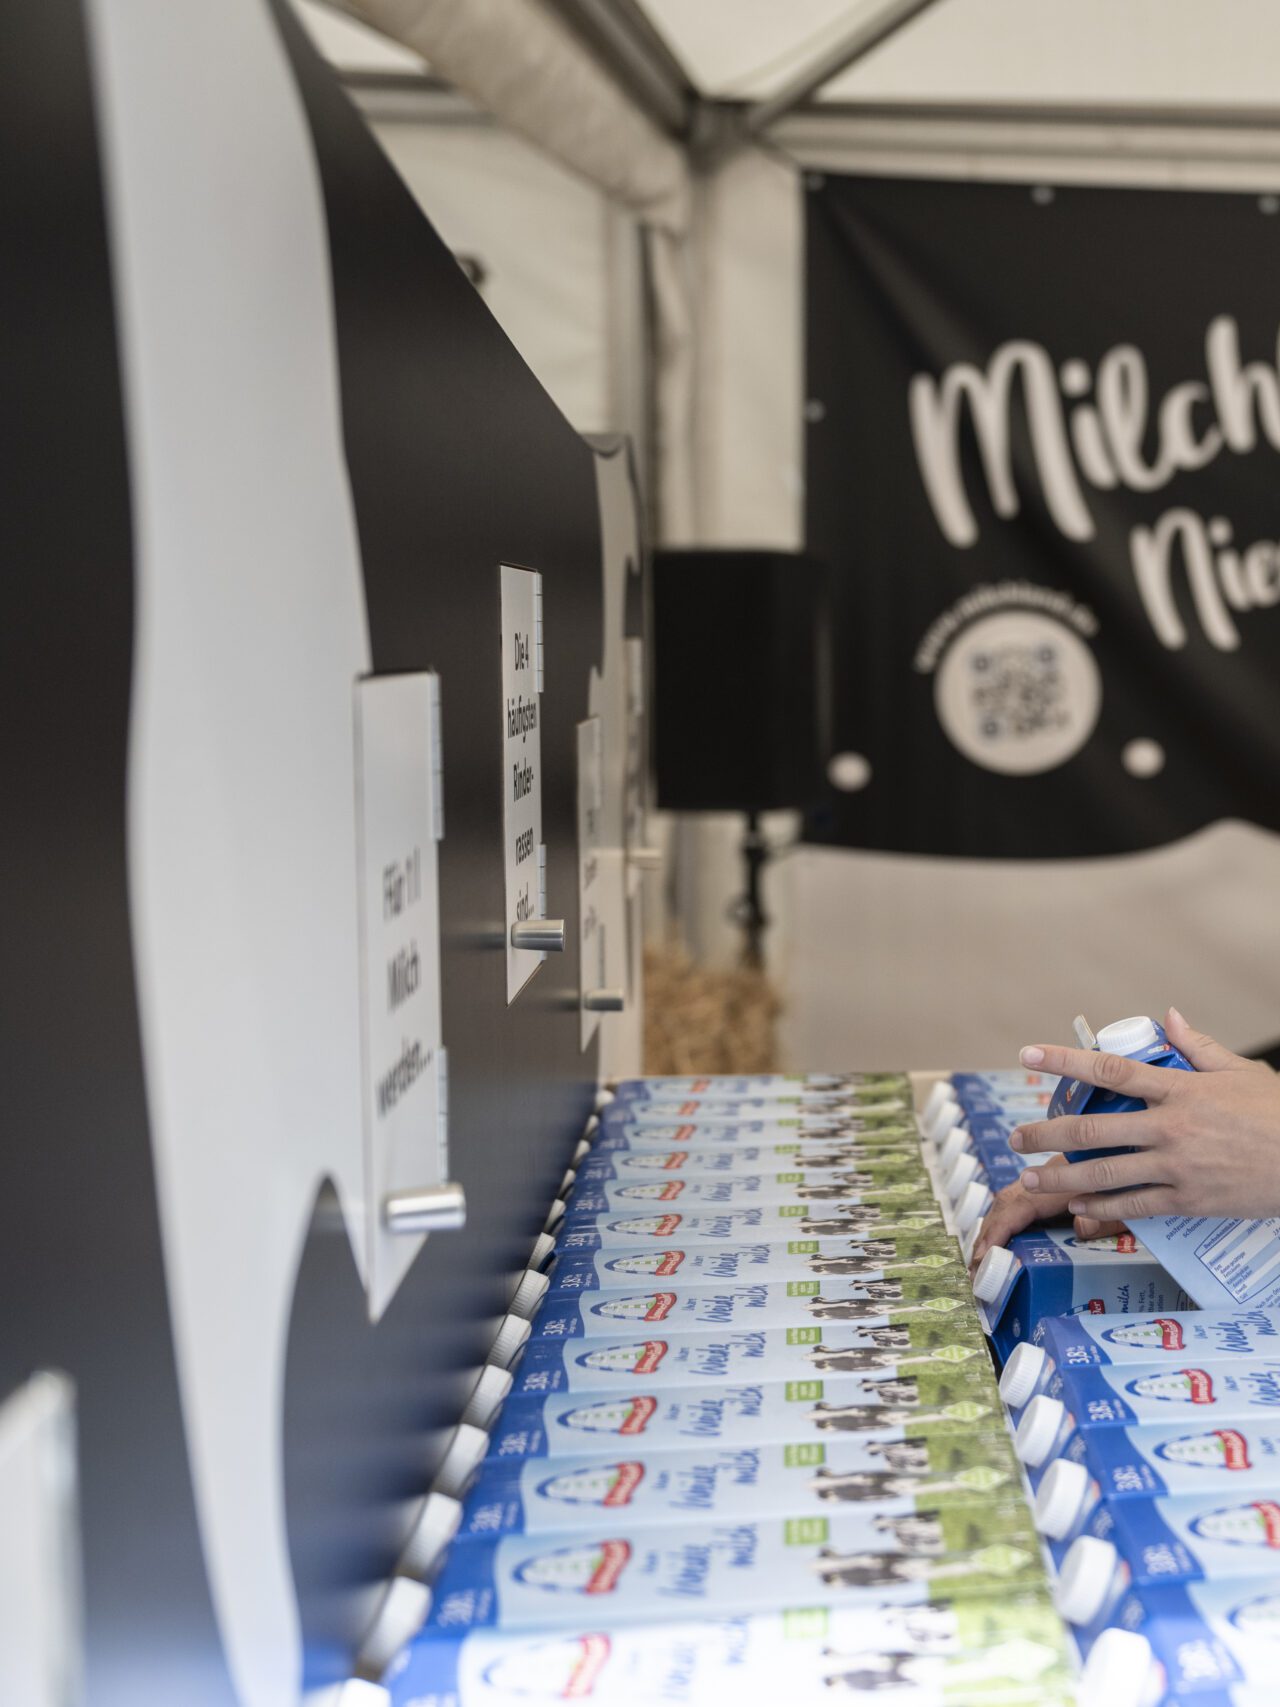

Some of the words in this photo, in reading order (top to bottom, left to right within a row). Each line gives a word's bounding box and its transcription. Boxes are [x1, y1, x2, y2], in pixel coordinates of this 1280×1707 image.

[514, 634, 524, 671] Die
[507, 696, 538, 743] häufigsten
[513, 758, 535, 802] Rinder-
[515, 827, 534, 866] rassen
[386, 939, 421, 1014] Milch
[703, 1252, 740, 1278] Weide
[739, 1244, 771, 1264] milch
[696, 1294, 736, 1323] Weide
[734, 1285, 769, 1308] milch
[1208, 1321, 1254, 1353] Weide
[1233, 1310, 1279, 1336] milch
[689, 1343, 731, 1376] Weide
[728, 1332, 766, 1358] milch
